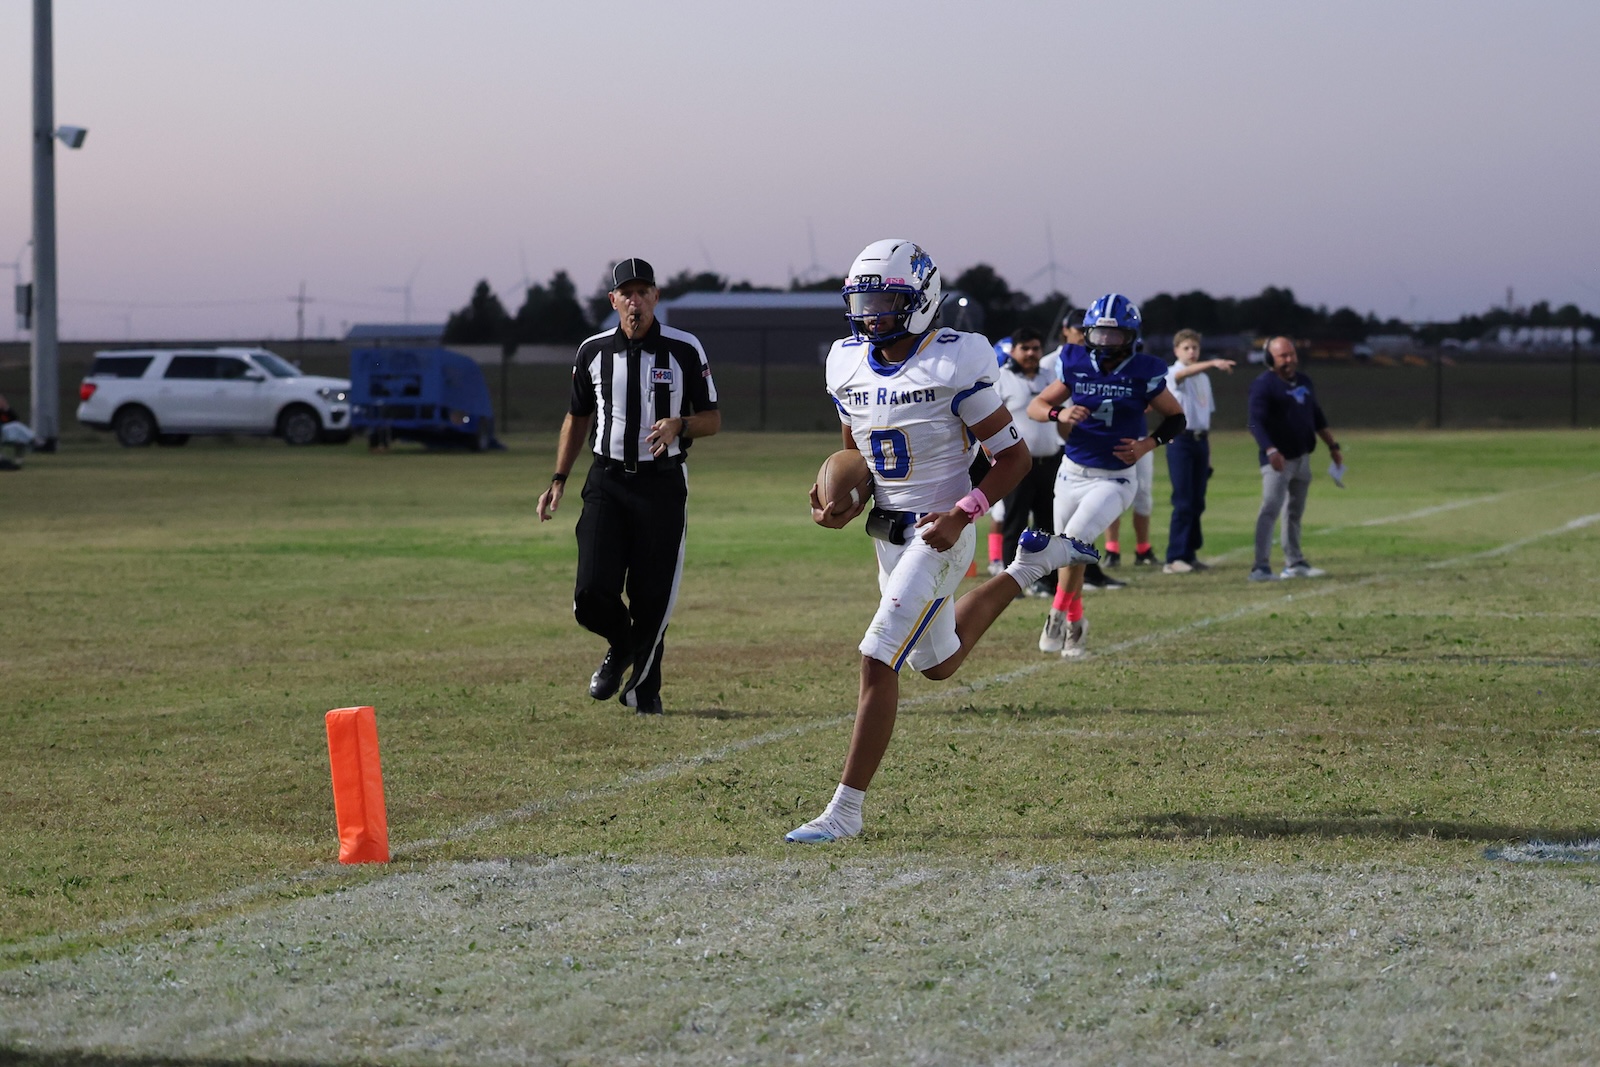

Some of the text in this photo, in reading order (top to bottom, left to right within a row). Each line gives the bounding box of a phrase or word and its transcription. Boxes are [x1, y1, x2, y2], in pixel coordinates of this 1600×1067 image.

[846, 387, 936, 405] THE RANCH
[1091, 399, 1114, 427] 4
[1009, 425, 1019, 440] 0
[869, 426, 913, 481] 0
